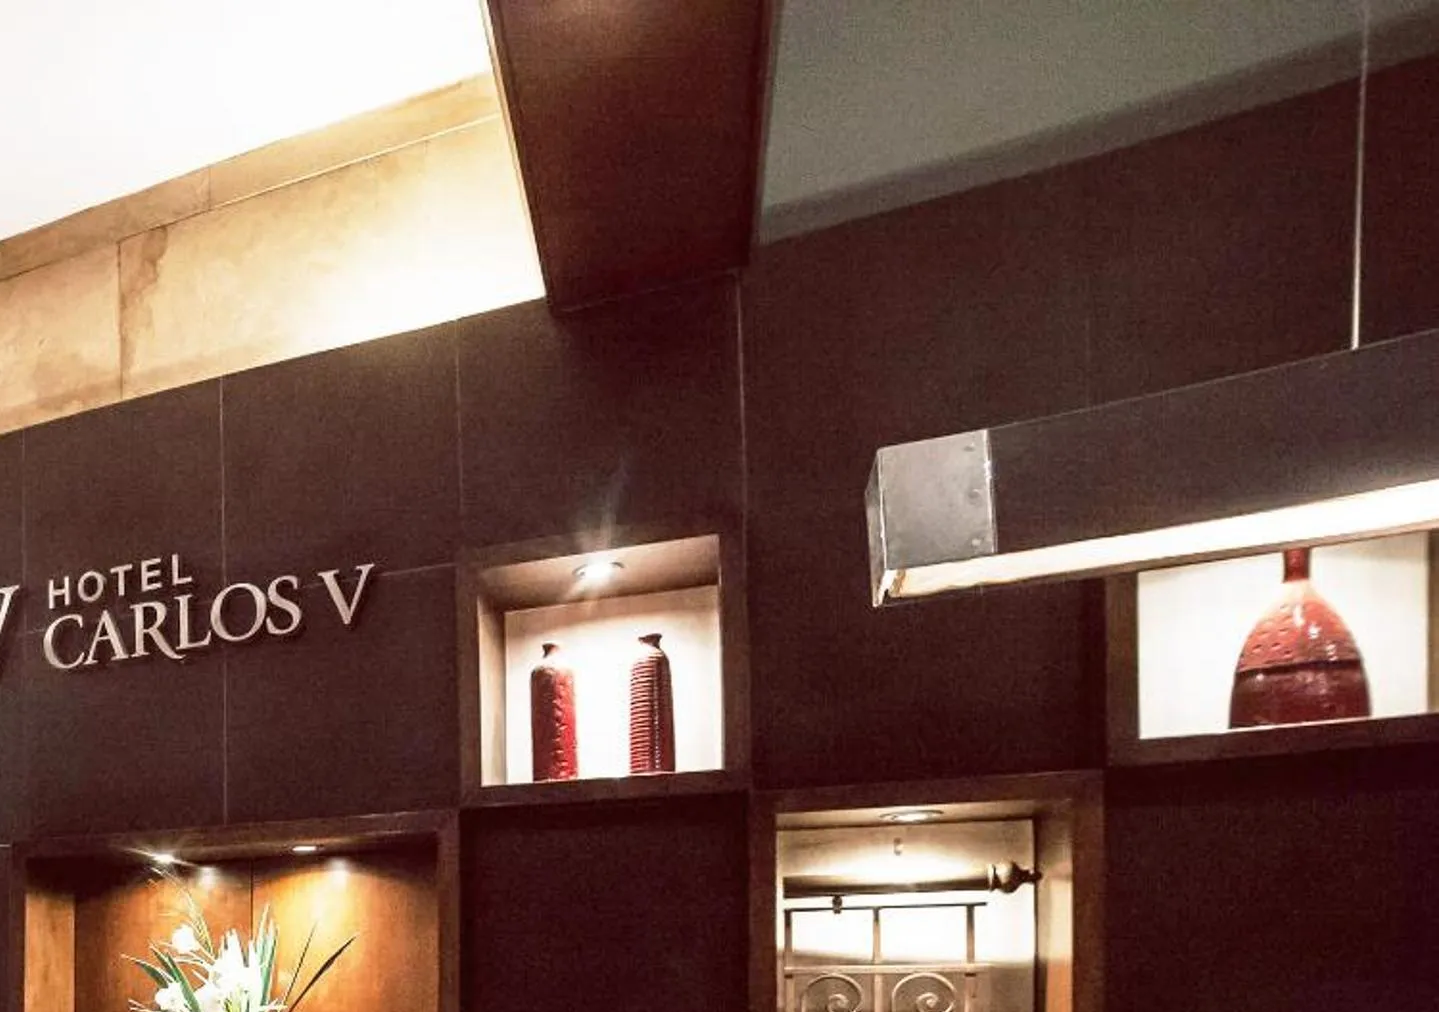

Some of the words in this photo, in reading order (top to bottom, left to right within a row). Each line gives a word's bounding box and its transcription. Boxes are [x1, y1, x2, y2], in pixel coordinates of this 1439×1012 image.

[42, 574, 303, 670] CARLOS
[317, 563, 376, 626] V
[48, 553, 193, 609] HOTEL
